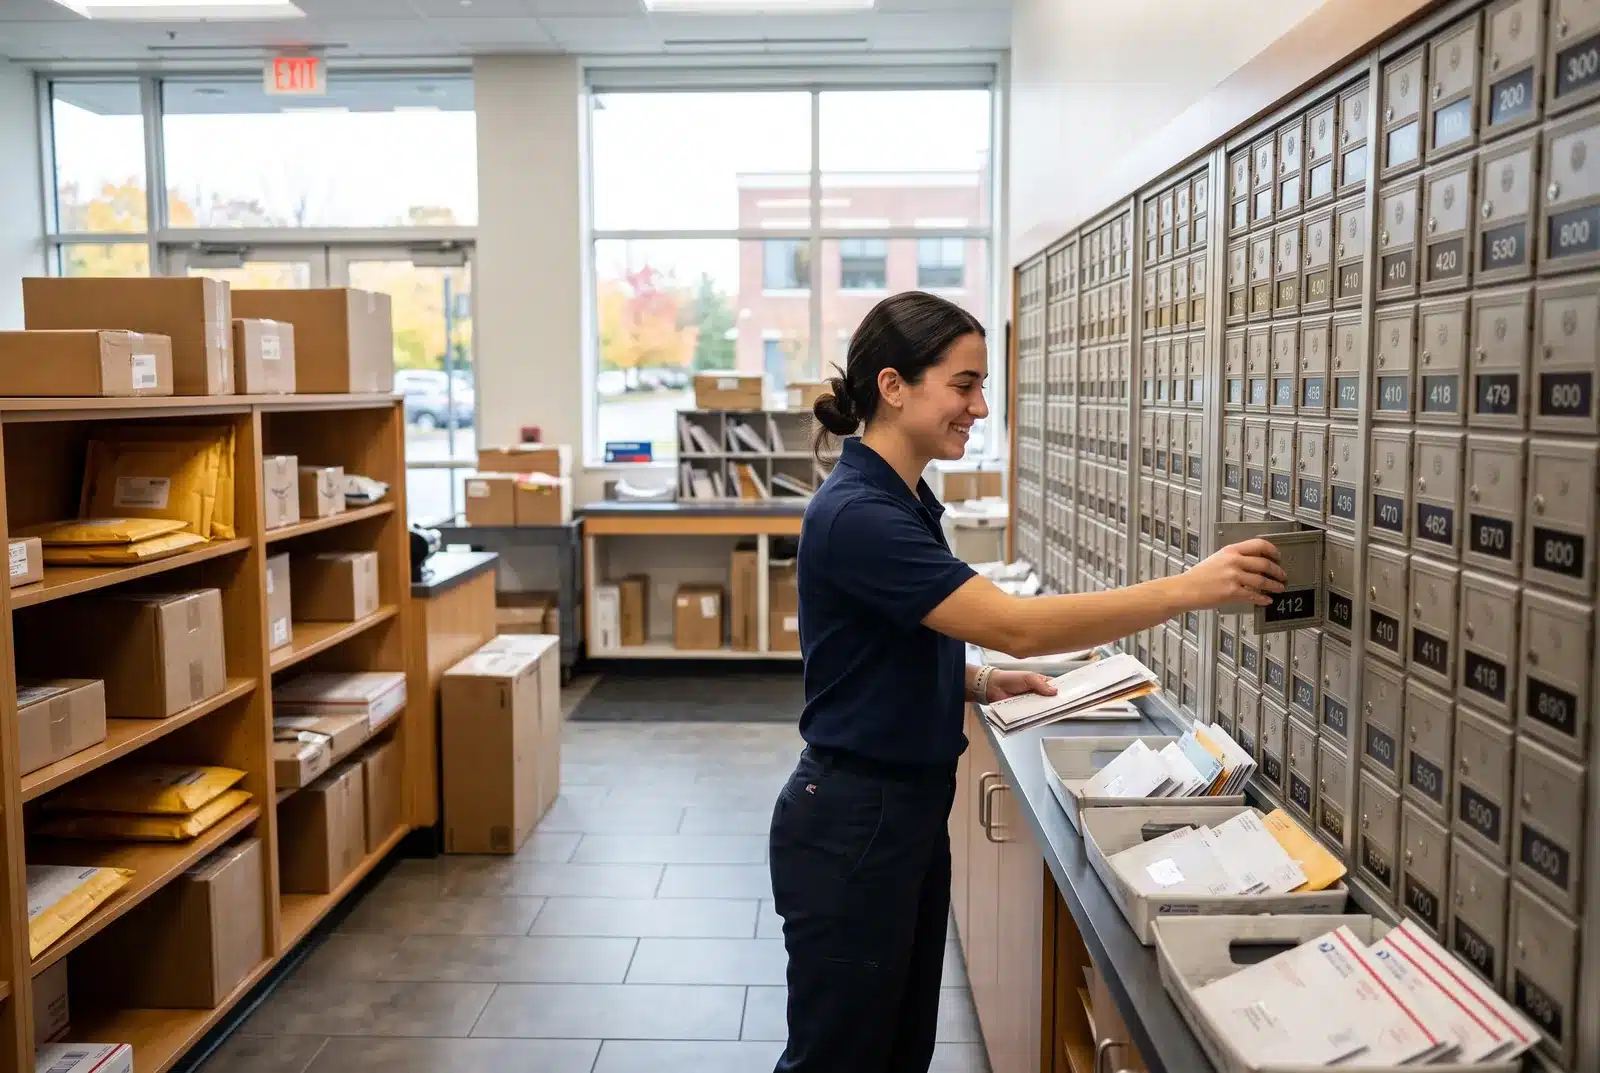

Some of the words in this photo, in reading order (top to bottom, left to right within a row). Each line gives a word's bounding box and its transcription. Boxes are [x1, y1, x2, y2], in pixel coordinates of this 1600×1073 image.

[273, 57, 320, 89] EXIT
[1567, 49, 1598, 83] 300
[1500, 82, 1525, 112] 200
[1492, 236, 1517, 261] 530
[1389, 261, 1406, 279] 410
[1435, 255, 1456, 272] 420
[1344, 273, 1359, 289] 410
[1341, 385, 1356, 401] 472
[1384, 386, 1402, 403] 410
[1430, 385, 1451, 404] 418
[1485, 384, 1511, 405] 479
[1337, 494, 1352, 512] 436
[1380, 508, 1398, 525] 470
[1425, 514, 1447, 536] 462
[1276, 597, 1303, 614] 412
[1333, 604, 1348, 621] 419
[1376, 621, 1393, 642] 410
[1421, 641, 1440, 663] 411
[1474, 668, 1498, 692] 418
[1329, 706, 1344, 728] 443
[1372, 736, 1390, 759] 440
[1411, 888, 1432, 917] 700
